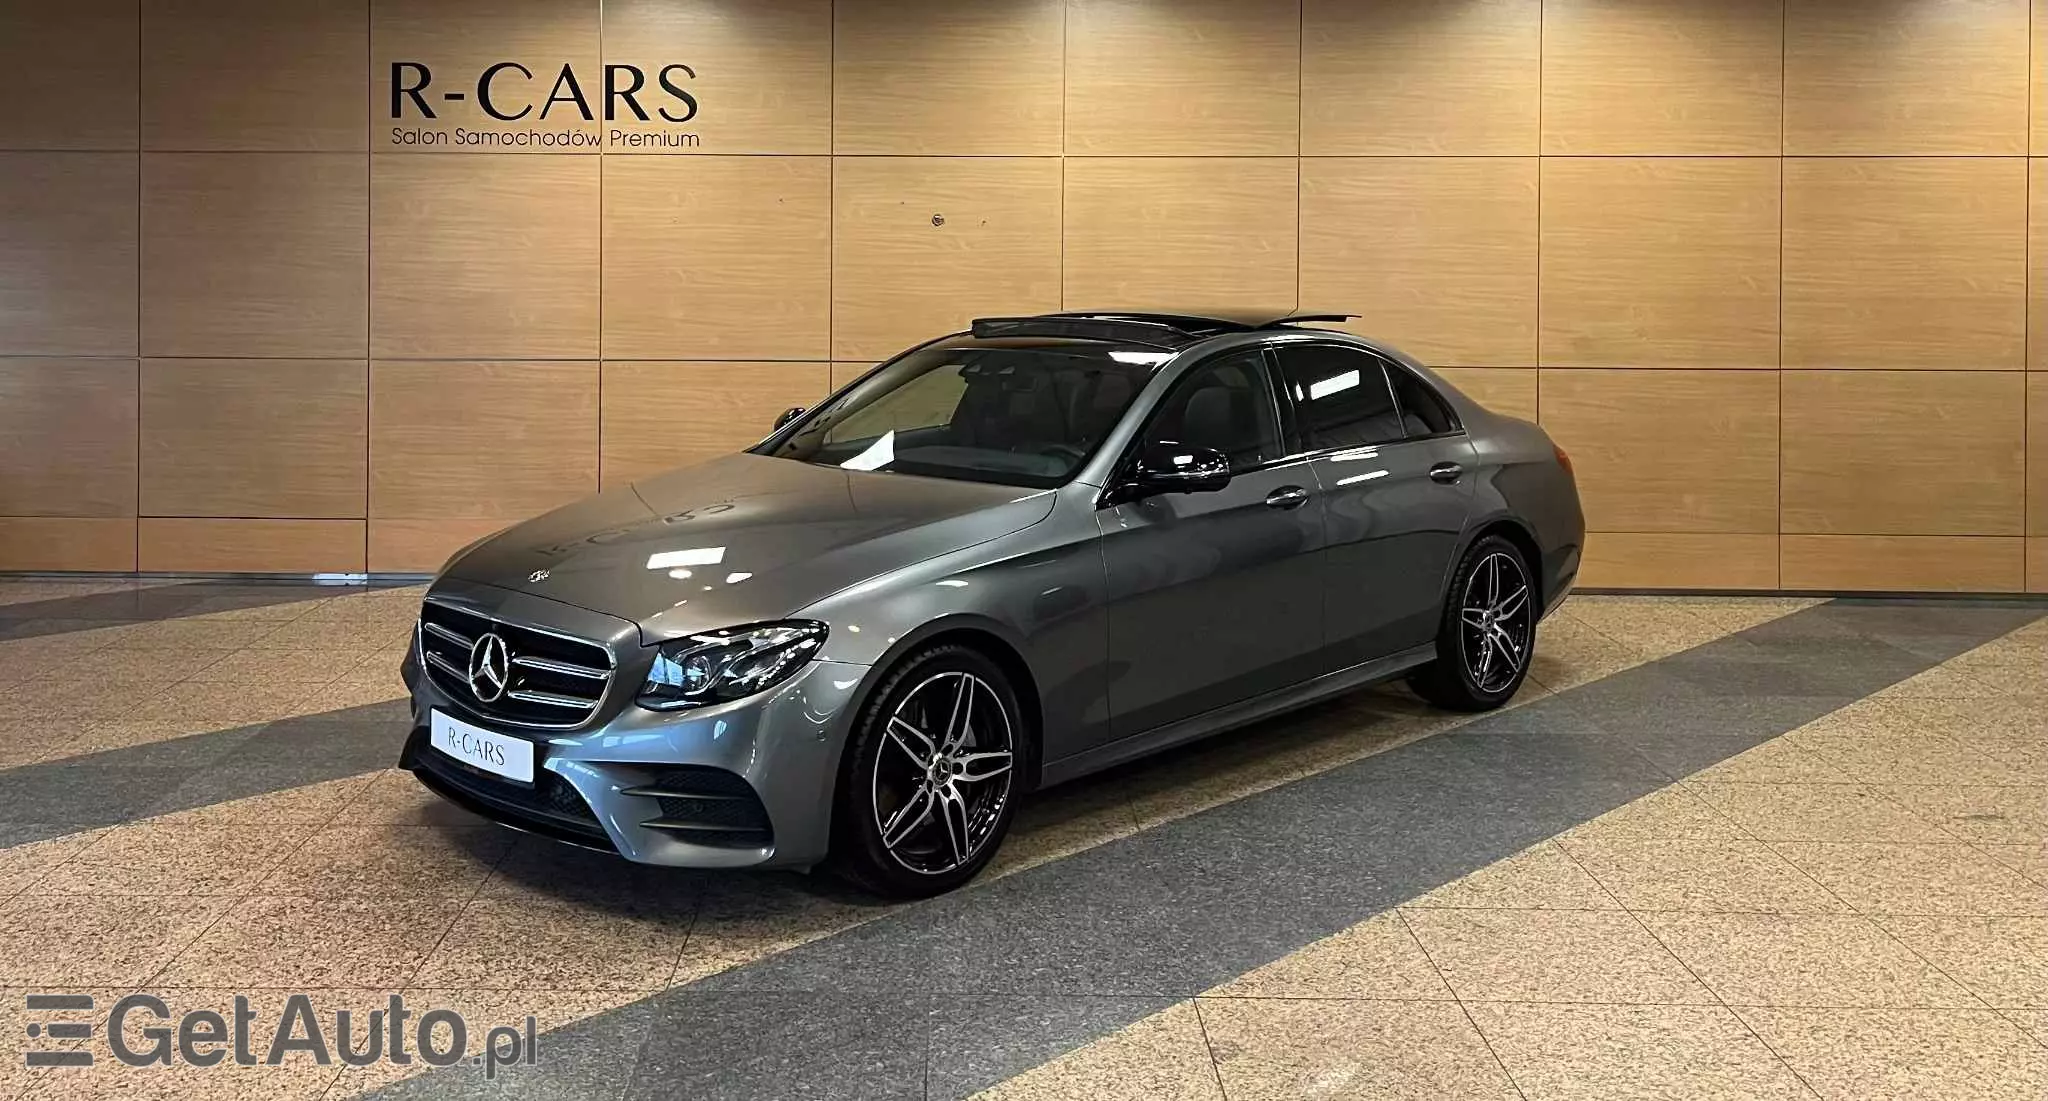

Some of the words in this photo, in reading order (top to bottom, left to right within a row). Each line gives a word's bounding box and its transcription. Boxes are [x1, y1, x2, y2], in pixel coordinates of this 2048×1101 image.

[391, 62, 698, 122] R-CARS
[391, 127, 448, 145] Salon
[455, 127, 602, 146] Samochodów
[610, 129, 700, 147] Premium
[448, 727, 505, 766] R-CARS
